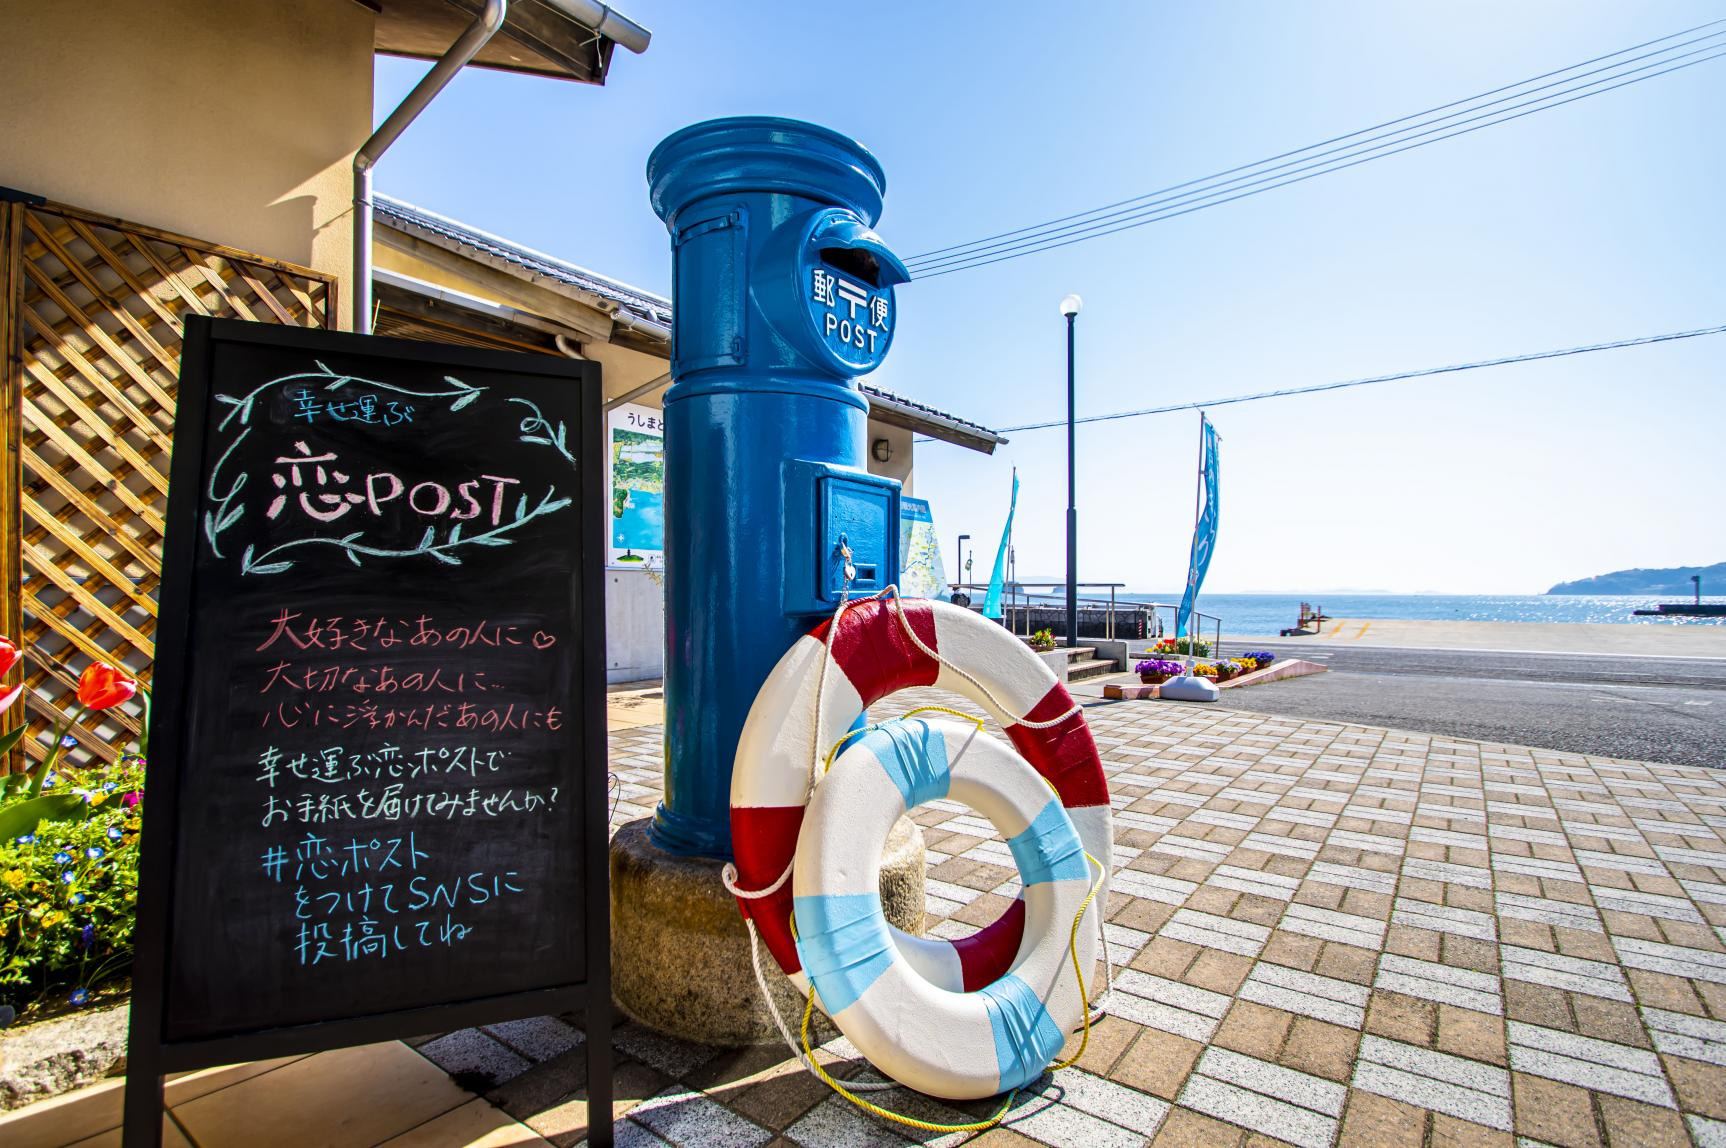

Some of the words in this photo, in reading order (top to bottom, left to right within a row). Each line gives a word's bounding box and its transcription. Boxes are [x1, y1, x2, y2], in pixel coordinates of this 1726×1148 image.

[826, 312, 877, 352] POST
[294, 389, 416, 426] 幸せ運ぶ
[262, 699, 563, 731] 心に浮かんだあの人にも
[256, 743, 511, 787] 幸せ運ぶ恋ポストで
